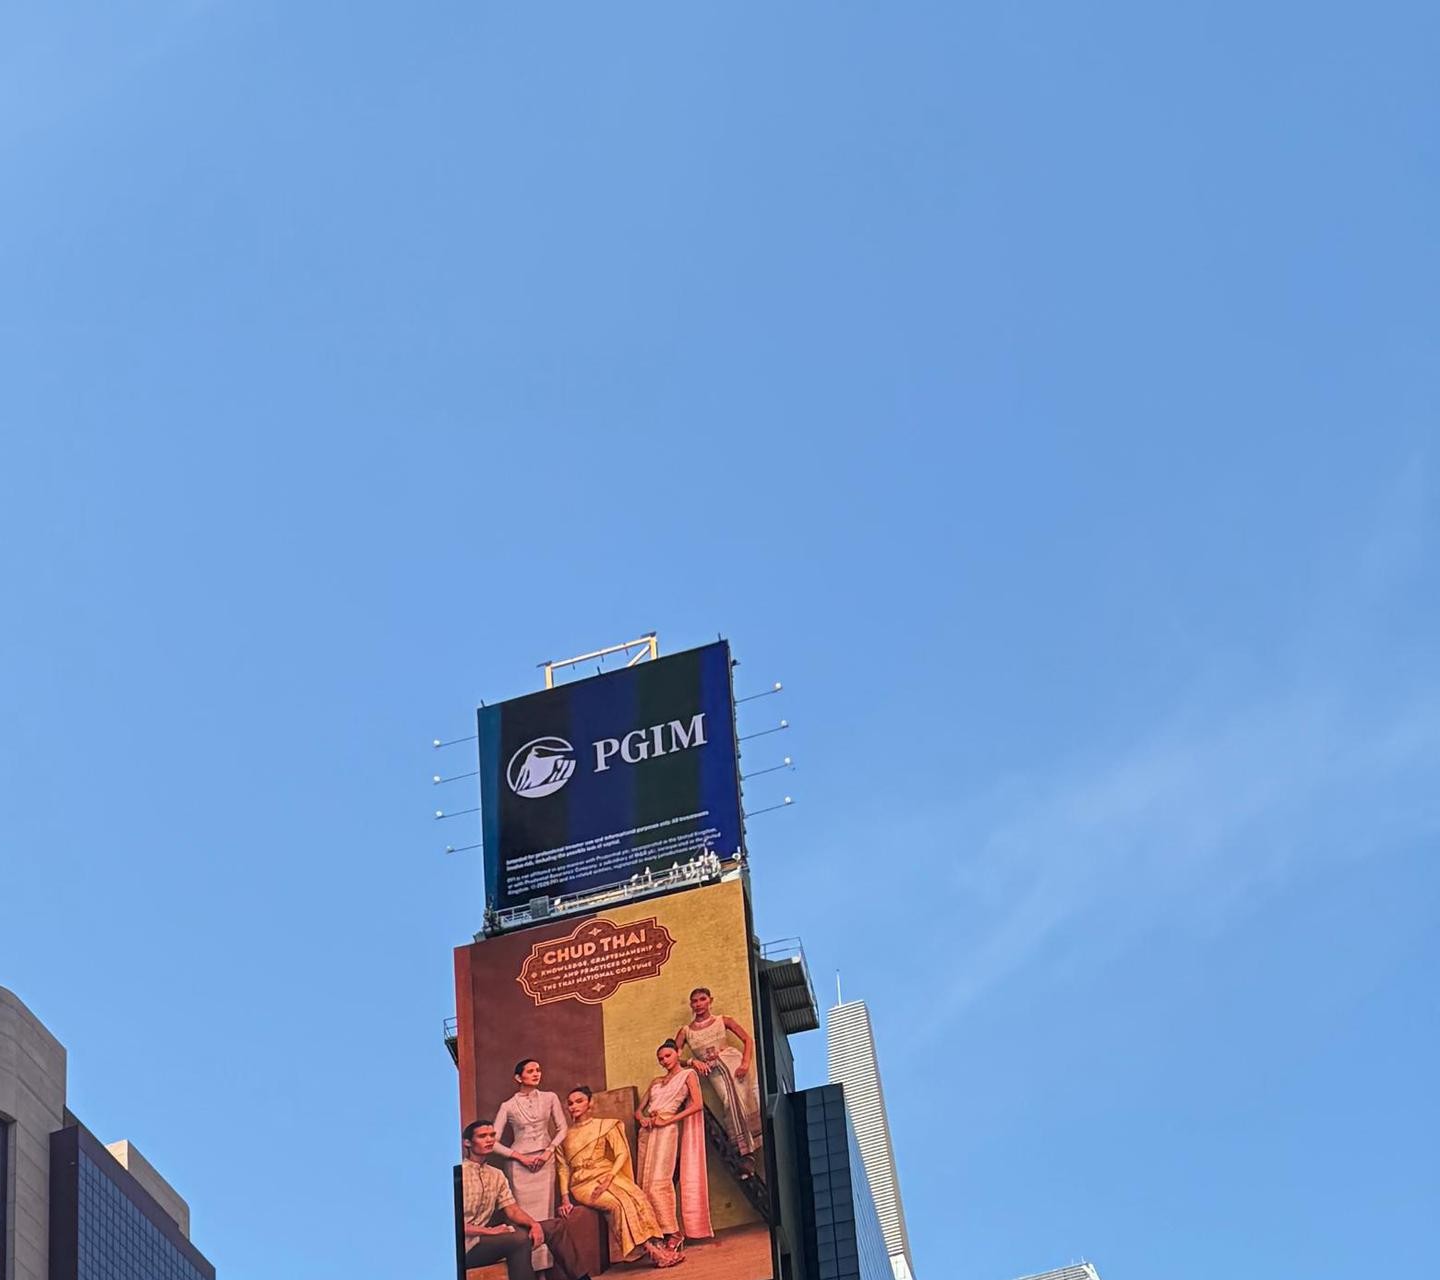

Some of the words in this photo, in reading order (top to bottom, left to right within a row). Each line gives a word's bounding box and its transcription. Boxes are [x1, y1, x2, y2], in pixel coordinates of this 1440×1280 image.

[592, 713, 708, 773] PGIM
[543, 942, 597, 965] CHUD
[600, 929, 646, 950] THAI
